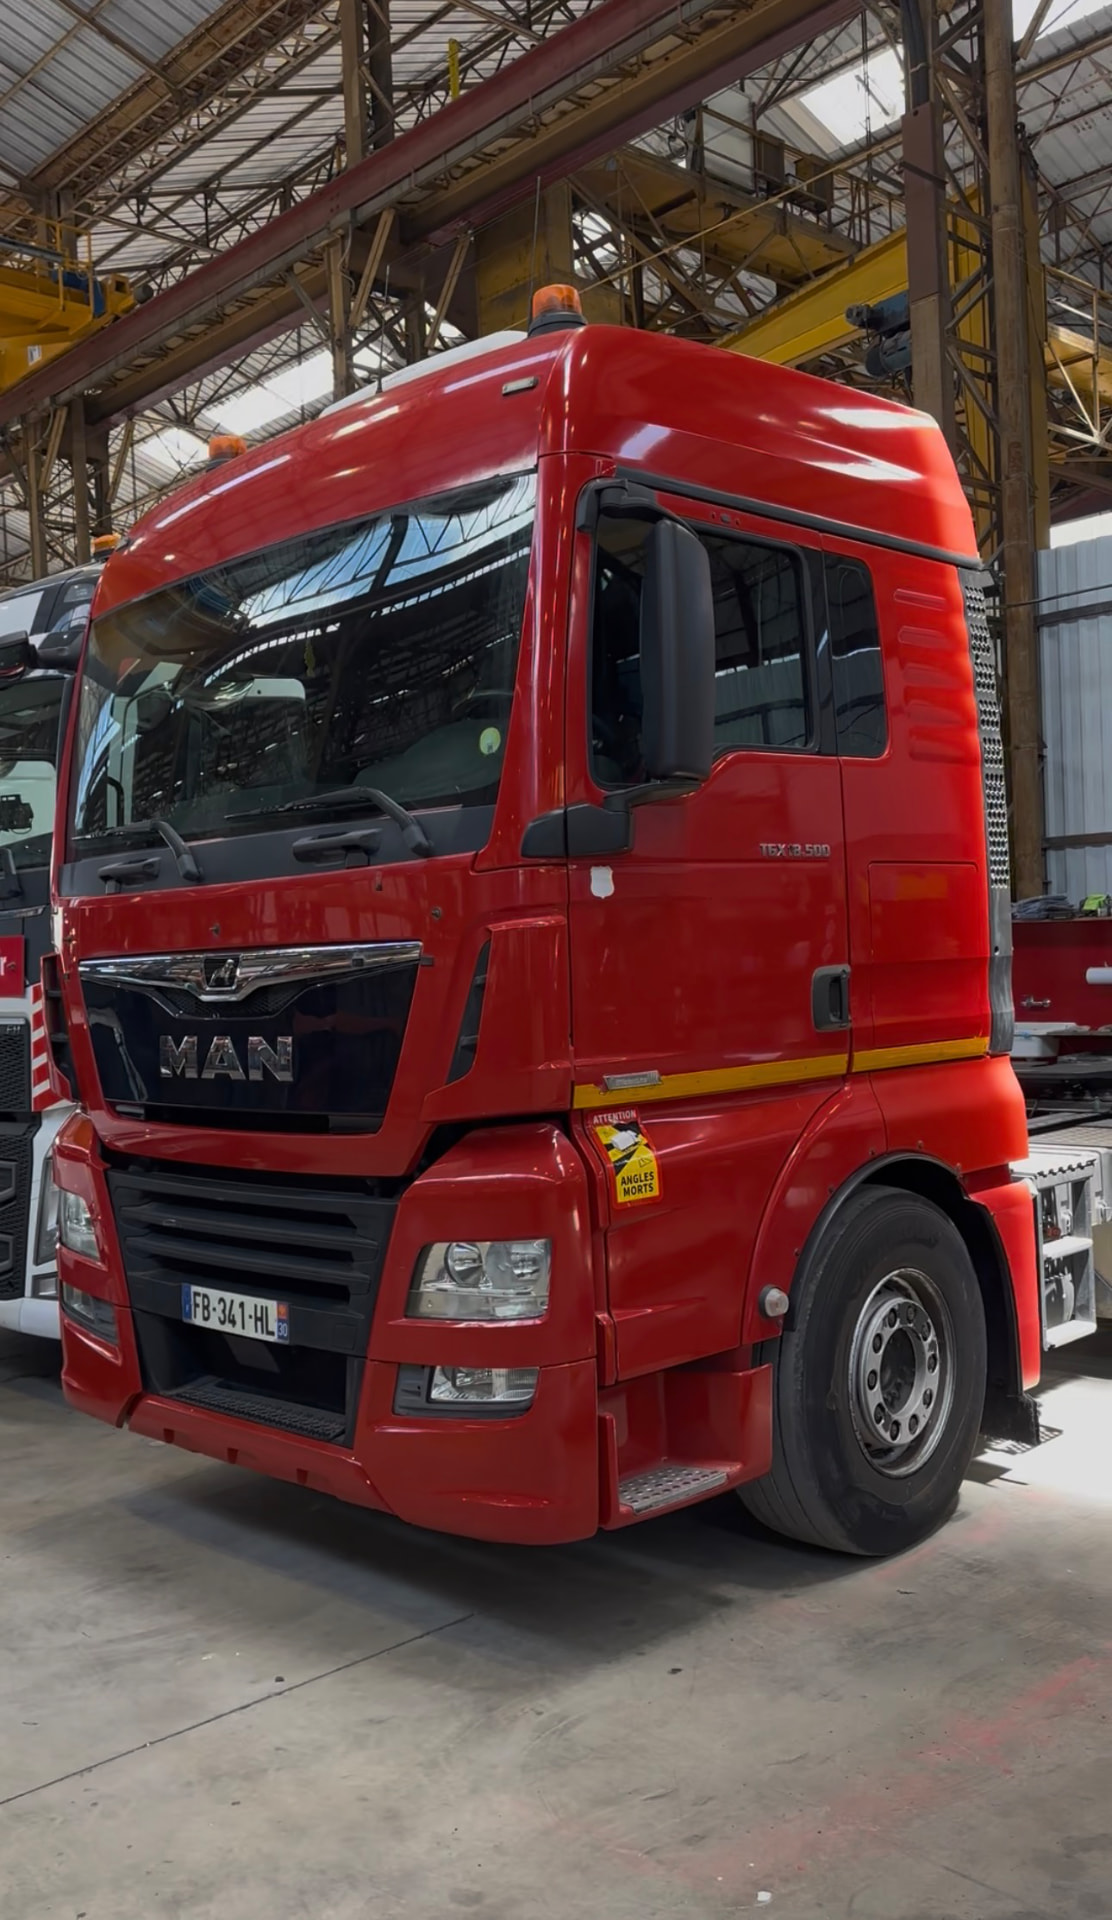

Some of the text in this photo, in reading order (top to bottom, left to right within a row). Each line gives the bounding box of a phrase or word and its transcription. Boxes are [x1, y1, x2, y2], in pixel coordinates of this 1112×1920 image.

[159, 1035, 293, 1081] MAN
[593, 1109, 637, 1125] ATTENTION
[621, 1171, 655, 1186] ANGLES
[623, 1182, 654, 1197] MORTS
[192, 1291, 276, 1336] FB-341-HL
[277, 1322, 288, 1337] 30
